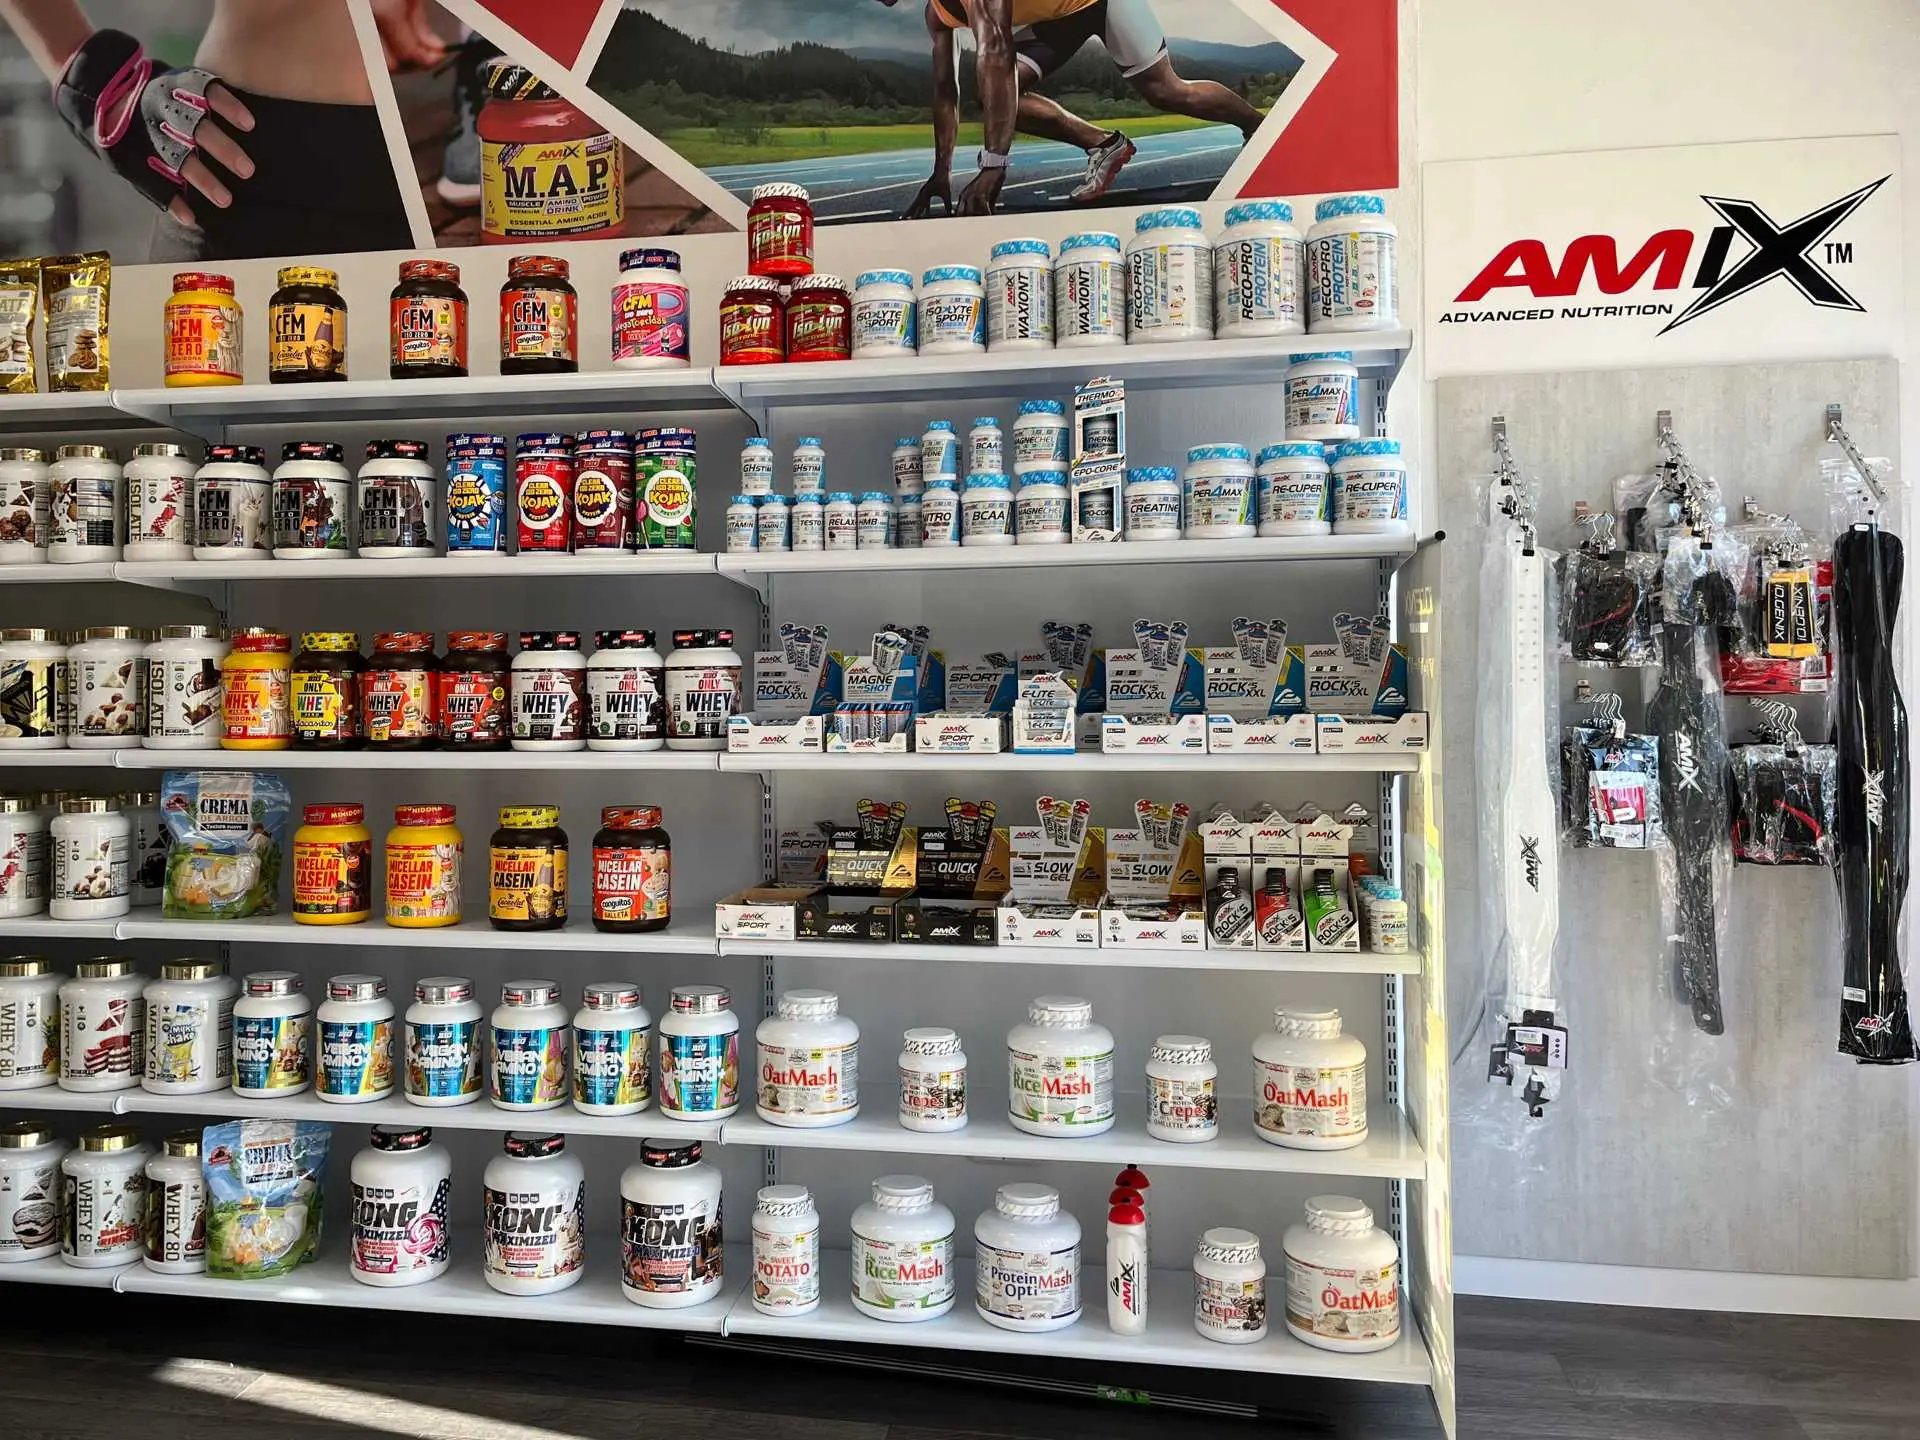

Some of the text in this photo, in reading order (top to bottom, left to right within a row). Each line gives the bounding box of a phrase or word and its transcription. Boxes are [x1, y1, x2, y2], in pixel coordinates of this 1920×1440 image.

[536, 143, 582, 162] AMIX
[546, 206, 579, 214] DRINK
[556, 216, 584, 224] AMINO
[587, 211, 608, 220] ACIDS
[1453, 174, 1893, 337] AMIX
[1254, 242, 1267, 308] PROTEIN
[1332, 239, 1345, 305] PROTEIN
[1144, 252, 1154, 317] PROTEIN
[1241, 242, 1253, 321] RECO-PRO
[1320, 240, 1332, 318] RECO-PRO
[1134, 254, 1144, 330] RECO-PRO
[622, 295, 652, 312] CFM
[1018, 272, 1030, 340] WAXIONT
[1079, 268, 1090, 334] WAXIONT
[513, 301, 546, 322] CFM
[1439, 304, 1673, 324] ADVANCED NUTRITION
[276, 313, 305, 334] CFM
[401, 308, 433, 330] CFM
[864, 319, 900, 328] SPORT
[936, 314, 971, 323] SPORT
[516, 335, 544, 344] conguitos
[1078, 390, 1116, 402] THERMO
[1292, 384, 1342, 399] PER4MAX
[976, 442, 998, 450] BCAA
[1074, 464, 1118, 477] EPO-CORE
[1193, 485, 1242, 498] PER4MAX
[1272, 483, 1322, 494] RE-CUPER
[1346, 482, 1397, 494] RE-CUPER
[364, 488, 396, 508] CFM
[448, 495, 487, 508] KOJAK
[521, 496, 558, 508] KOJAK
[576, 491, 612, 505] KOJAK
[650, 490, 689, 504] KOJAK
[1130, 503, 1180, 514] CREATINE
[972, 511, 1004, 520] BCAA
[364, 516, 396, 529] ZERO
[1774, 584, 1784, 640] IO.GENIX
[1794, 587, 1807, 641] IO.GENIX
[1110, 652, 1138, 662] AMIX
[1208, 651, 1236, 660] AMIX
[1309, 648, 1338, 658] AMIX
[848, 675, 894, 685] MAGNE
[950, 673, 1001, 682] SPORT
[304, 682, 323, 692] ONLY
[373, 682, 392, 692] ONLY
[454, 682, 476, 692] ONLY
[533, 680, 555, 692] ONLY
[618, 680, 642, 691] ONLY
[698, 679, 721, 690] ONLY
[864, 684, 890, 692] SHOT
[950, 682, 989, 690] POWER
[151, 660, 164, 736] ISOLATE
[788, 691, 809, 700] XXL
[1022, 690, 1056, 698] E-LITE
[1145, 690, 1166, 700] XXL
[1245, 689, 1266, 698] XXL
[1348, 688, 1369, 696] XXL
[224, 693, 260, 709] WHEY
[298, 695, 332, 711] WHEY
[368, 696, 401, 711] WHEY
[448, 696, 484, 713] WHEY
[522, 695, 569, 713] WHEY
[606, 694, 654, 713] WHEY
[686, 692, 733, 712] WHEY
[533, 726, 550, 734] 80
[618, 725, 637, 734] 80
[942, 724, 970, 734] AMIX
[760, 734, 792, 745] AMIX
[1136, 734, 1171, 746] AMIX
[1244, 733, 1279, 745] AMIX
[1355, 732, 1391, 744] AMIX
[1672, 730, 1703, 794] AMIX
[1862, 766, 1888, 826] AMIX
[200, 798, 248, 814] CREMA
[200, 814, 249, 823] DE ARROZ
[921, 831, 948, 840] AMIX
[1014, 831, 1042, 840] AMIX
[1112, 832, 1140, 841] AMIX
[1210, 828, 1242, 839] AMIX
[1258, 828, 1294, 839] AMIX
[1306, 830, 1344, 840] AMIX
[780, 840, 828, 848] SPORT
[296, 858, 340, 870] MICELLAR
[388, 860, 433, 872] MICELLAR
[494, 860, 536, 872] MICELLAR
[598, 860, 642, 873] MICELLAR
[848, 860, 888, 870] QUICK
[938, 862, 978, 874] QUICK
[1034, 862, 1074, 872] SLOW
[1520, 833, 1542, 891] AMIX
[56, 840, 66, 898] WHEY 80
[865, 871, 884, 880] GEL
[1132, 864, 1172, 876] SLOW
[296, 871, 339, 887] CASEIN
[388, 874, 432, 890] CASEIN
[494, 873, 536, 888] CASEIN
[596, 874, 642, 891] CASEIN
[957, 874, 976, 882] GEL
[1050, 874, 1071, 882] GEL
[1149, 876, 1170, 884] GEL
[602, 899, 632, 910] conguitos
[1214, 904, 1249, 938] ROCK'S
[1262, 913, 1297, 942] ROCK'S
[930, 926, 962, 938] AMIX
[1033, 928, 1064, 938] AMIX
[1317, 914, 1350, 945] ROCK'S
[1856, 1011, 1895, 1037] AMIX
[233, 1037, 276, 1050] VEGAN
[324, 1041, 370, 1056] VEGAN
[421, 1043, 468, 1056] VEGAN
[498, 1050, 545, 1062] VEGAN
[579, 1050, 626, 1063] VEGAN
[675, 1056, 723, 1069] VEGAN
[1013, 1069, 1092, 1096] RiceMash
[1160, 1101, 1208, 1121] Crepes
[79, 1180, 92, 1230] WHEY
[166, 1187, 180, 1262] WHEY 80
[493, 1234, 557, 1246] MAXIMIZED
[634, 1246, 700, 1259] MAXIMIZED
[758, 1262, 810, 1277] POTATO
[865, 1258, 944, 1282] RiceMash
[990, 1266, 1038, 1286] Protein
[1038, 1269, 1073, 1288] Mash
[1119, 1252, 1137, 1312] AMIX
[1005, 1283, 1038, 1300] Opti
[1200, 1298, 1250, 1323] Crepes
